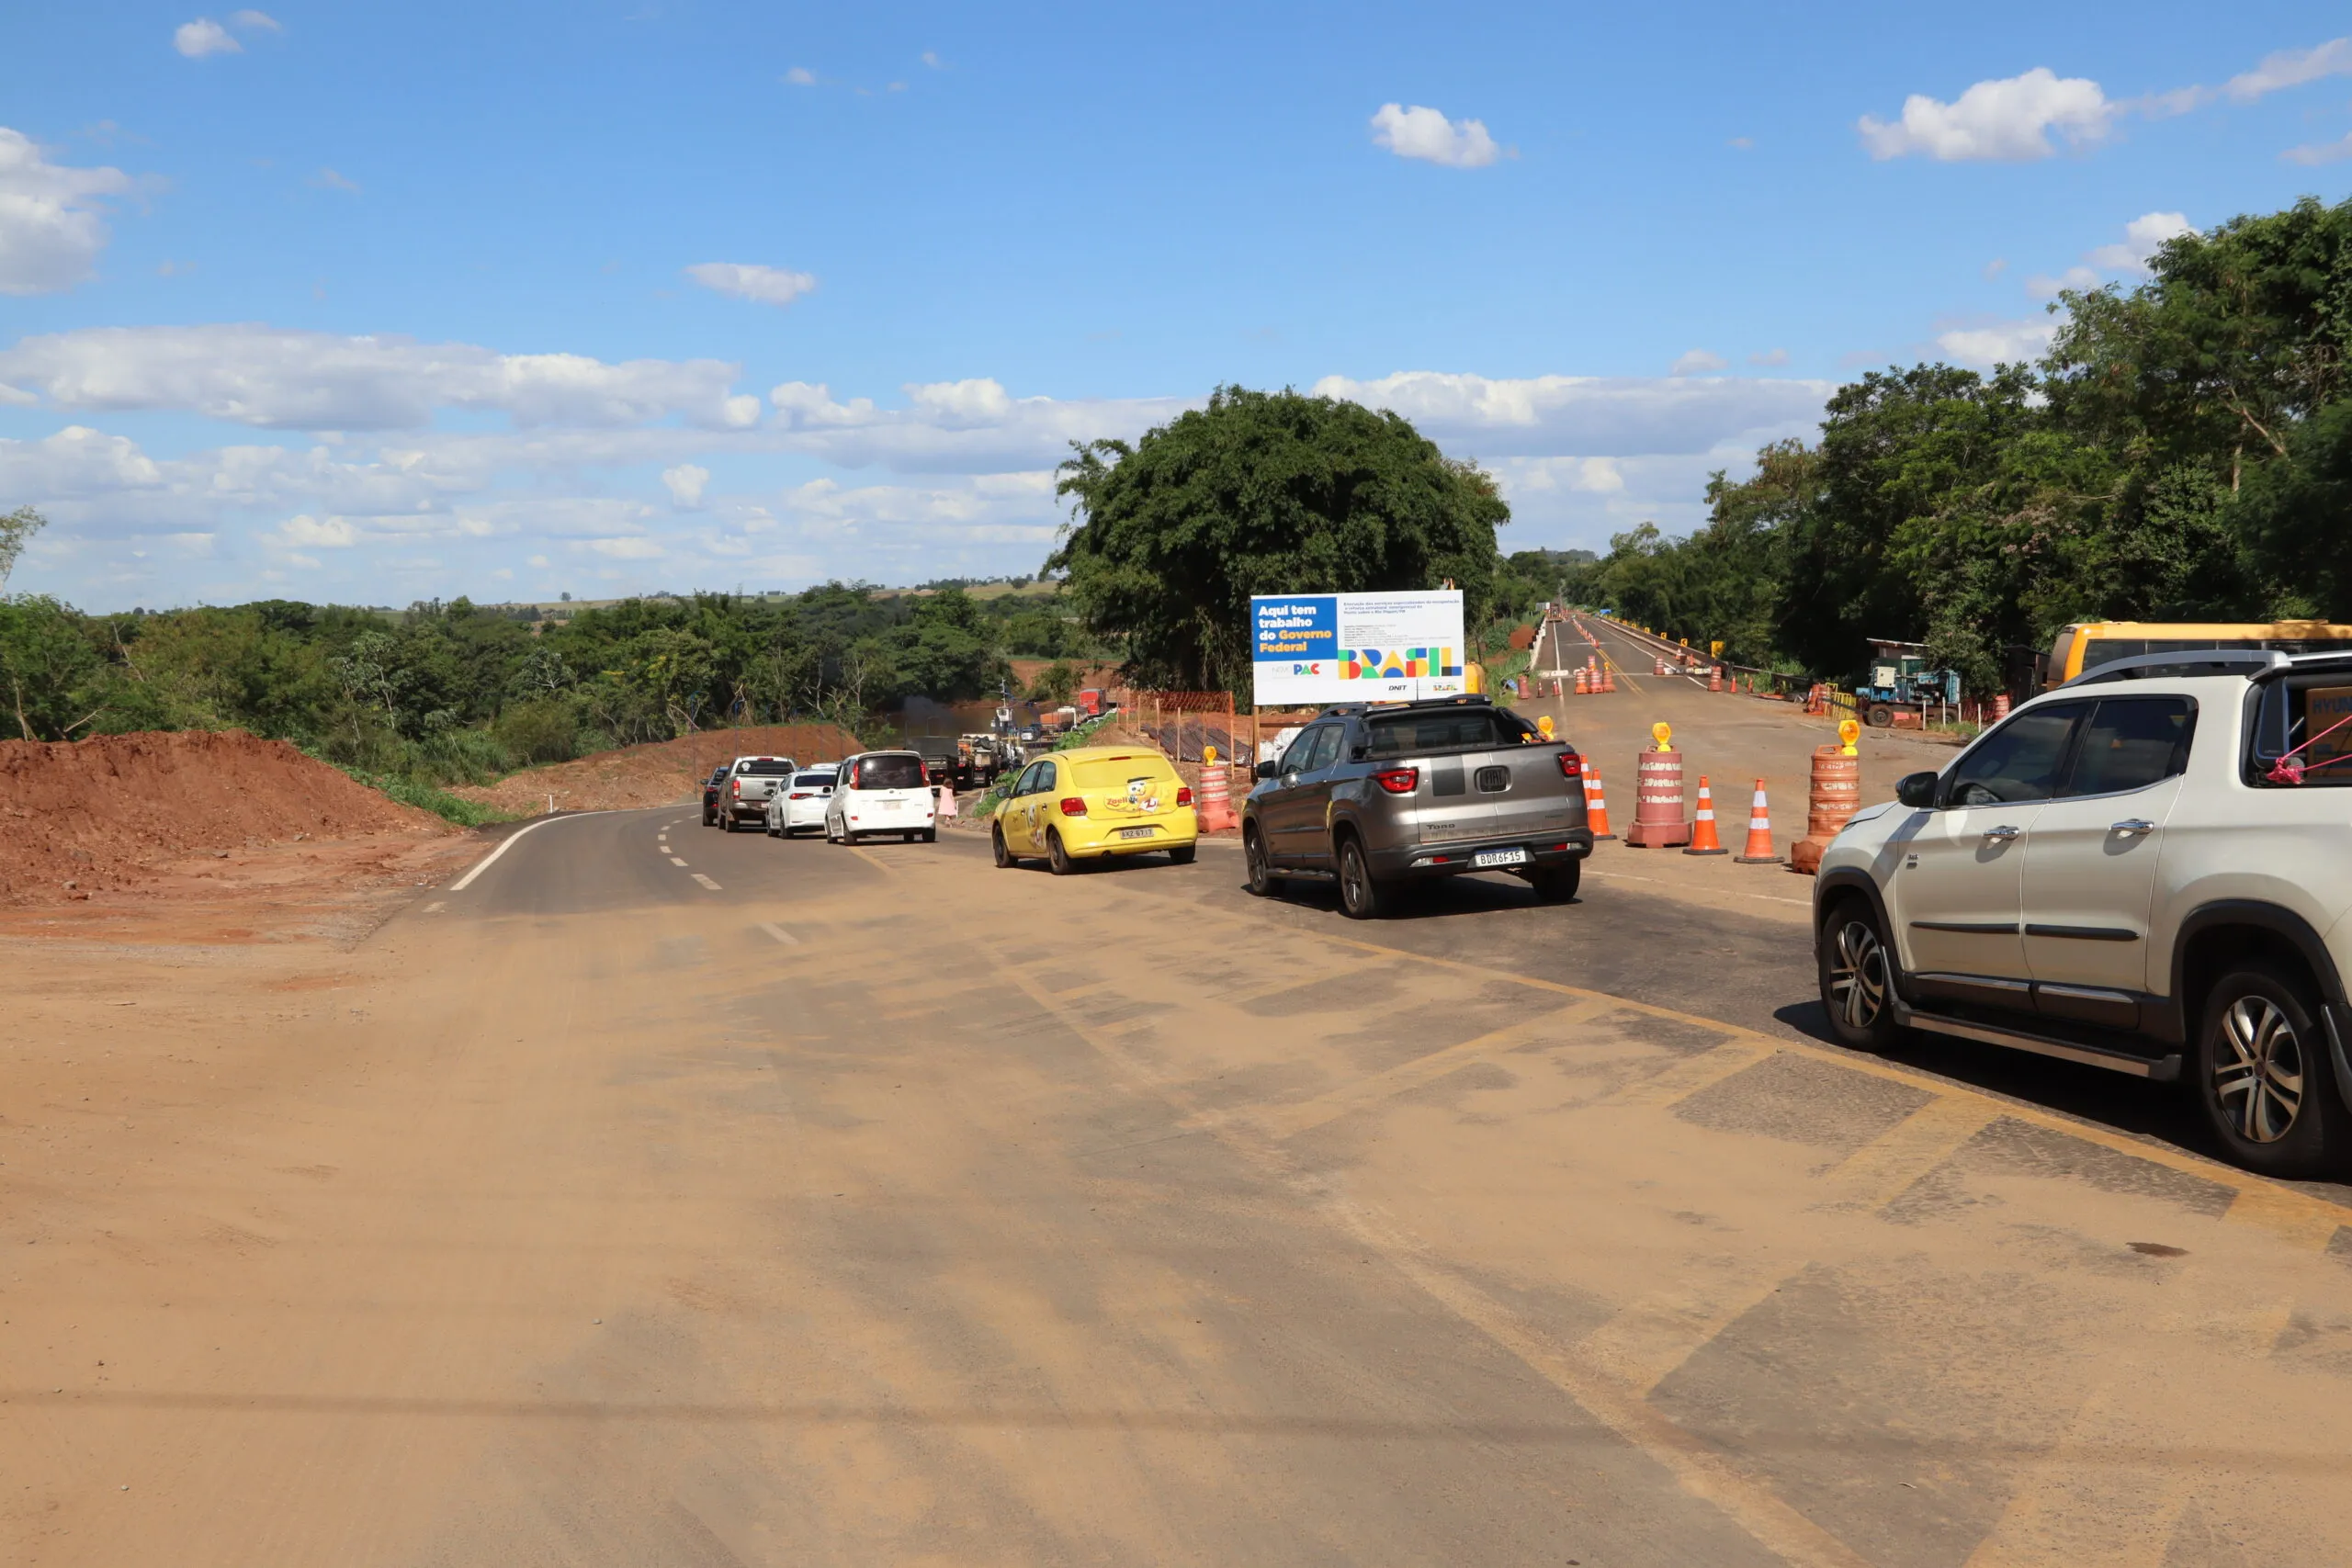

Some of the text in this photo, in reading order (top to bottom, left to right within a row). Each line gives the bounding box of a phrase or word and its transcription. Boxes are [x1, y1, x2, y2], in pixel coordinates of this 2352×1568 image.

[1259, 605, 1317, 617] Aqui tem
[1259, 617, 1313, 628] trabalho
[1259, 630, 1276, 640] do
[1279, 629, 1332, 639] Governo
[1260, 641, 1307, 652] Federal
[1294, 663, 1320, 675] PAC
[1338, 647, 1463, 680] BRASIL
[1480, 851, 1521, 864] BDR6F15
